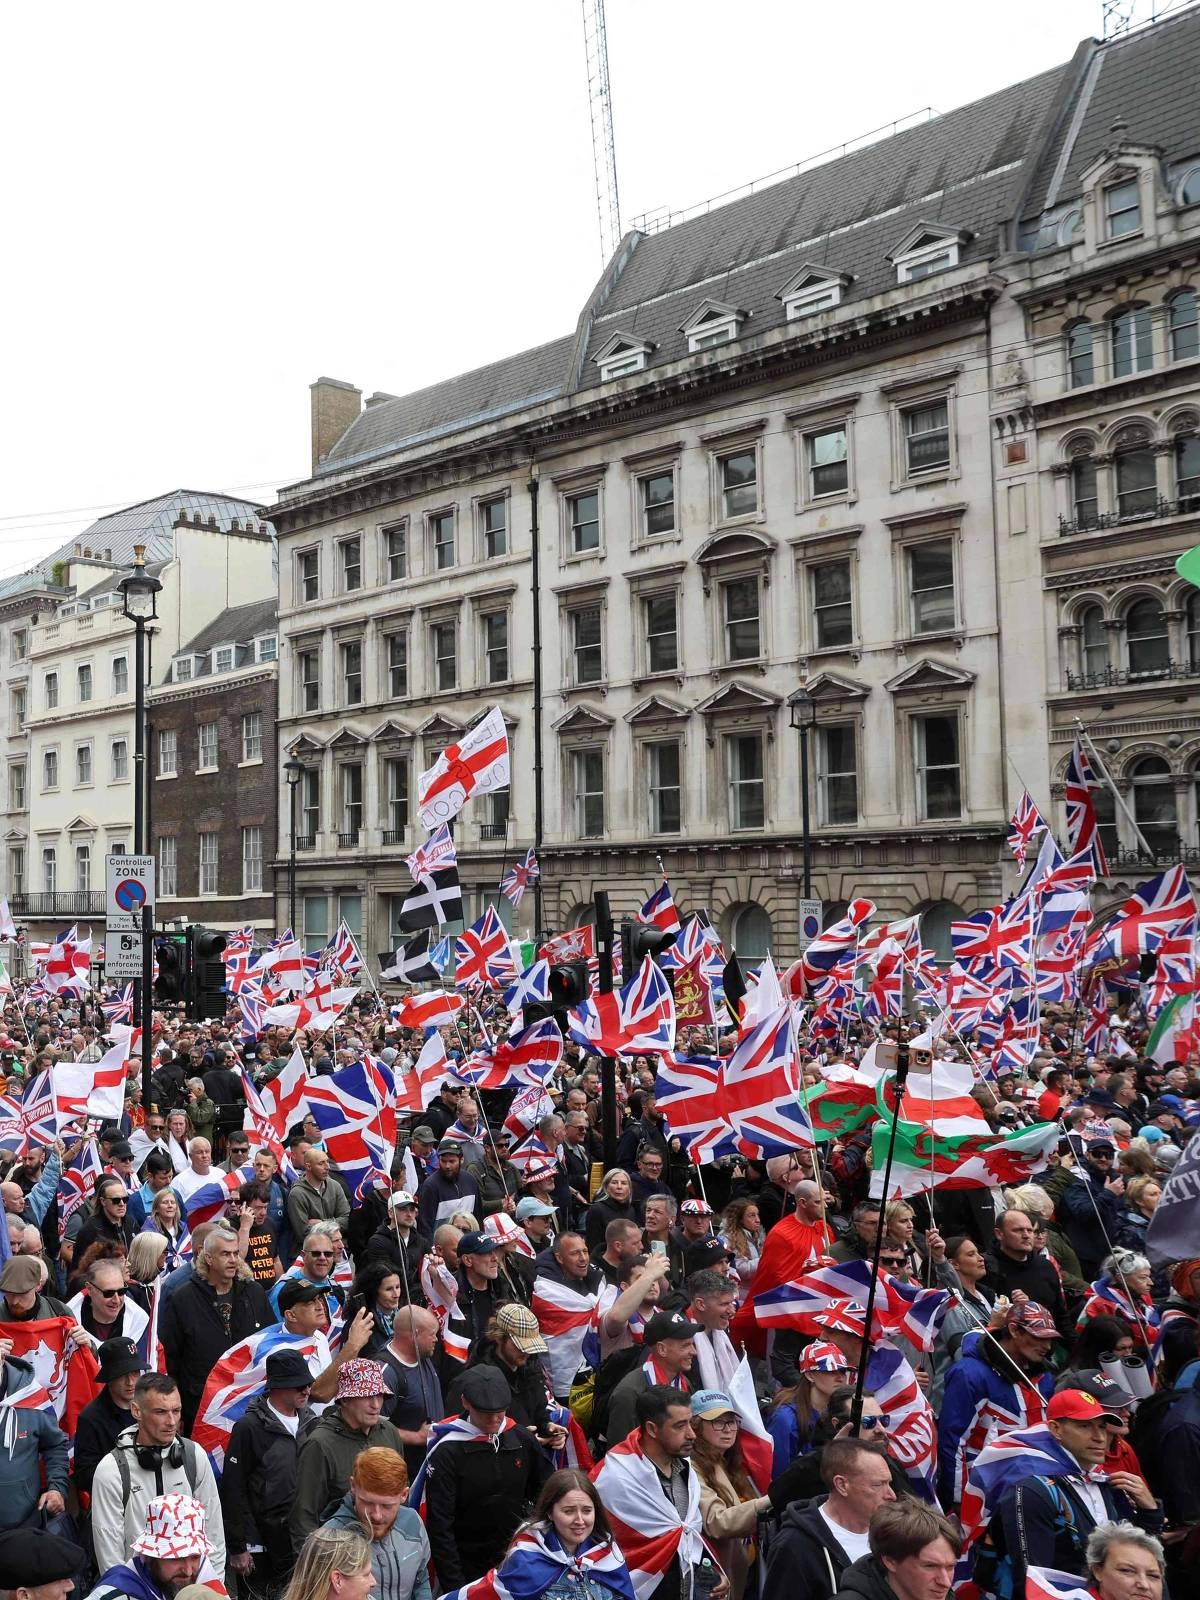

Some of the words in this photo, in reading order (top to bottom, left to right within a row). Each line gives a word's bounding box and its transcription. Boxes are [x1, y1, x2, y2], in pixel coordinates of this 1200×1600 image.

[109, 858, 152, 866] Controlled
[115, 867, 146, 877] ZONE
[107, 960, 143, 968] enforceme
[249, 1234, 272, 1246] USTICE
[253, 1247, 269, 1257] FOR
[700, 1393, 730, 1403] LONDON
